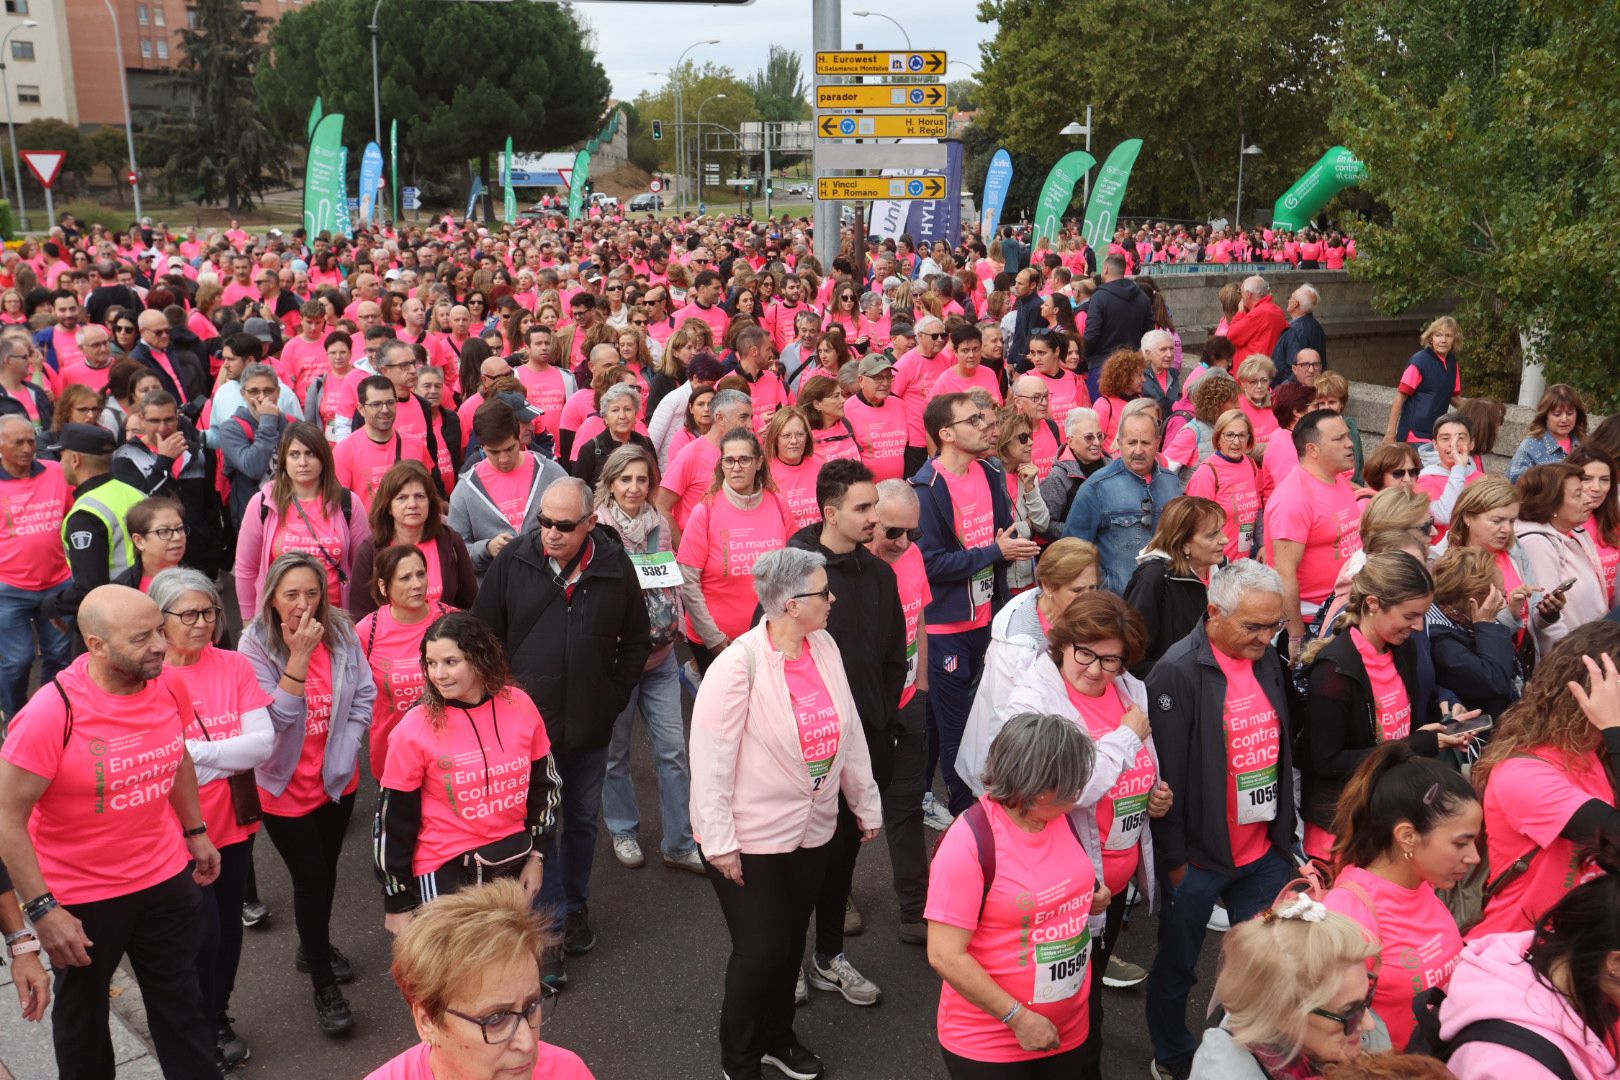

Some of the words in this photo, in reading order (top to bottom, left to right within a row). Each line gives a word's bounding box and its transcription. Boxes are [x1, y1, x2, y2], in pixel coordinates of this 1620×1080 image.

[820, 92, 857, 102] parador
[920, 127, 944, 136] Regio
[872, 439, 899, 448] contra
[874, 447, 905, 458] cánce
[11, 503, 24, 514] En
[13, 511, 53, 524] contra
[15, 520, 62, 536] cánce
[285, 534, 300, 543] En
[730, 540, 744, 550] En
[746, 538, 782, 548] marcha
[641, 565, 668, 577] 9382
[391, 672, 409, 684] En
[394, 686, 424, 697] con
[800, 713, 815, 726] En
[1231, 718, 1248, 730] En
[1250, 709, 1278, 723] marc
[1382, 713, 1395, 725] En
[1232, 726, 1278, 749] contra
[804, 738, 837, 759] cán
[1232, 745, 1278, 768] cánc
[109, 756, 133, 773] En
[110, 762, 177, 791] contra
[455, 770, 478, 785] En
[457, 780, 517, 802] contra
[518, 770, 530, 785] el
[1034, 911, 1055, 925] En
[1049, 949, 1087, 981] 10596
[1424, 968, 1443, 988] En
